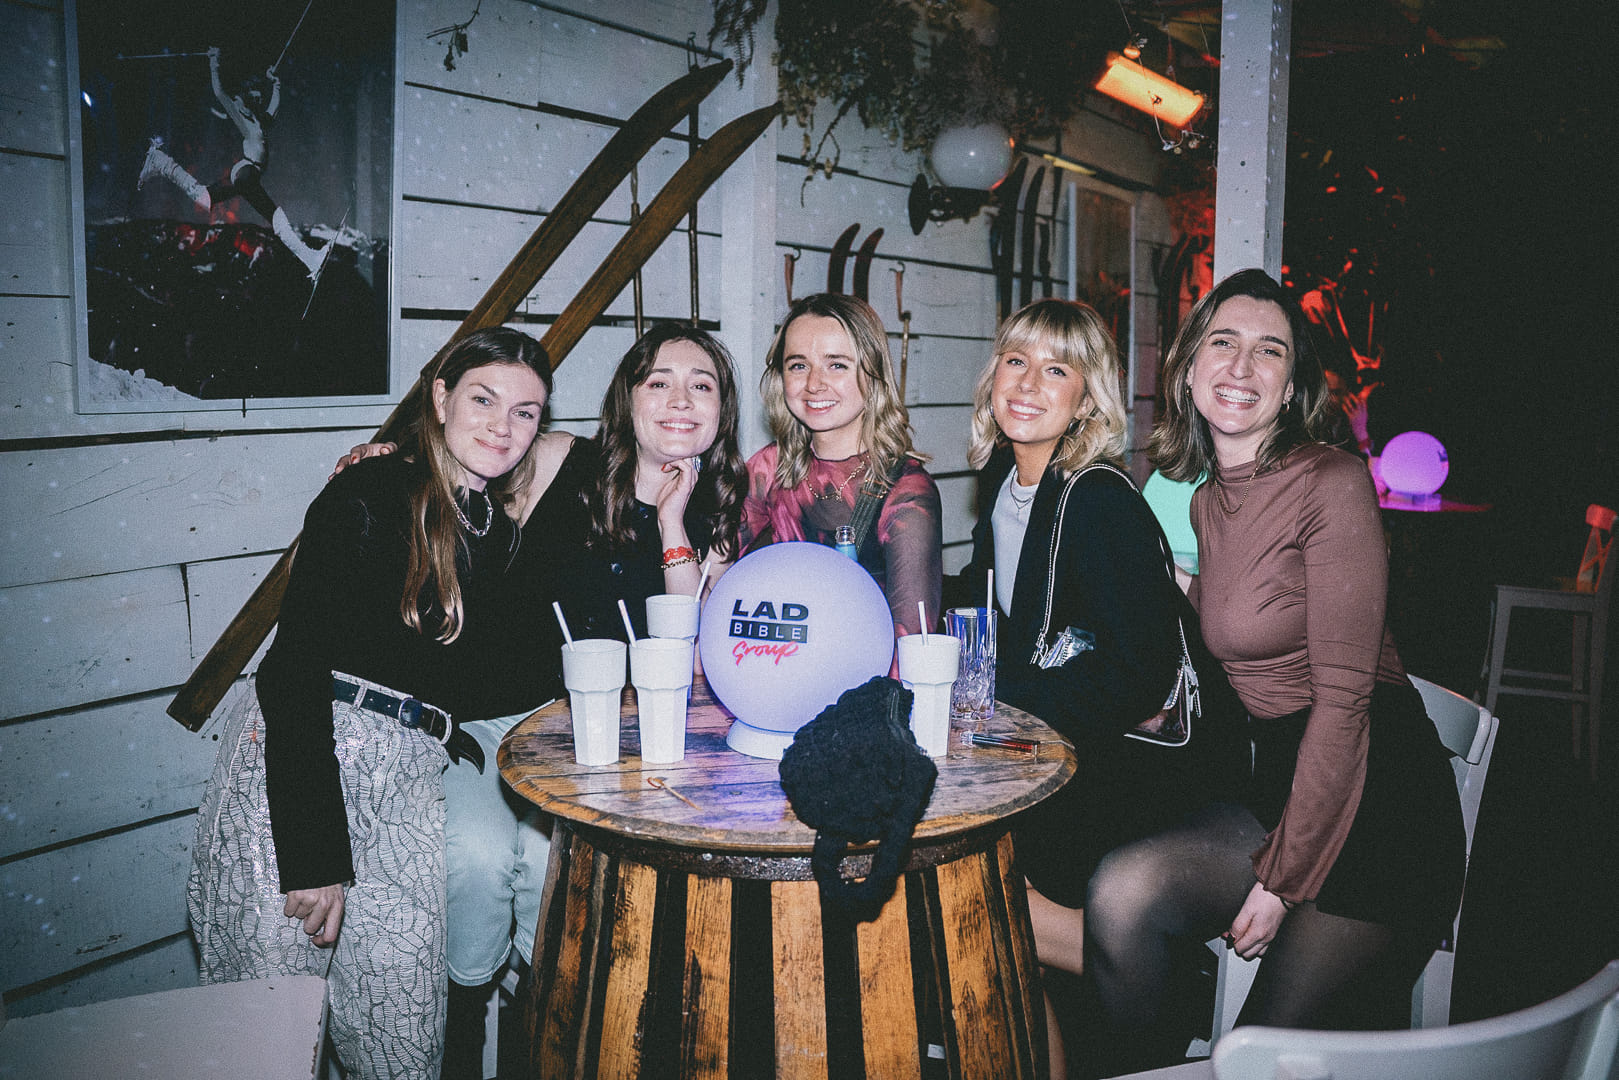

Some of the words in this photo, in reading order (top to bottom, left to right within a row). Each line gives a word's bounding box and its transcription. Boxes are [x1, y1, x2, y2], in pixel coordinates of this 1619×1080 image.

[732, 599, 809, 621] LAD
[733, 622, 802, 640] BIBLE
[732, 640, 799, 666] Group
